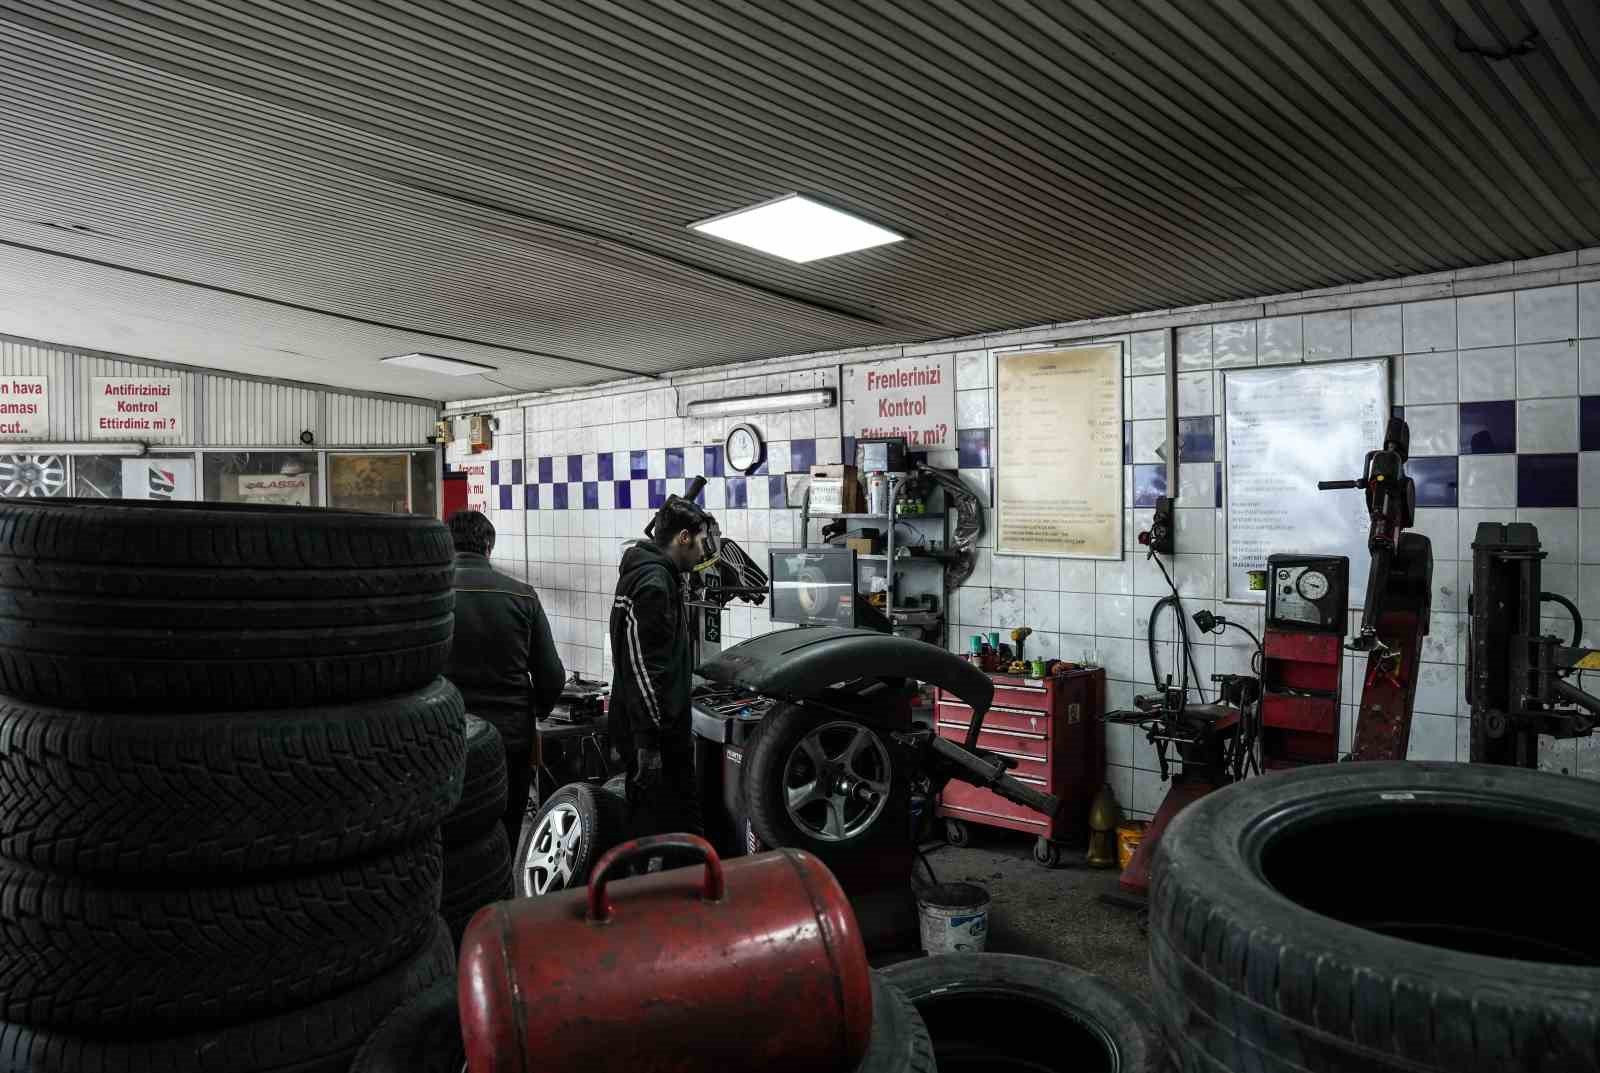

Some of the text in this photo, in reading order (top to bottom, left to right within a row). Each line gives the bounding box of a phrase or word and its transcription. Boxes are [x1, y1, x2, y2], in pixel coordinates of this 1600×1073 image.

[867, 365, 941, 391] Frenlerinizi
[0, 380, 42, 394] n hava
[105, 384, 170, 396] Antifirizinizi
[118, 401, 158, 412] Kontrol
[879, 396, 926, 418] Kontrol
[100, 418, 176, 429] Ettirdiniz mi ?
[924, 424, 948, 445] mi?
